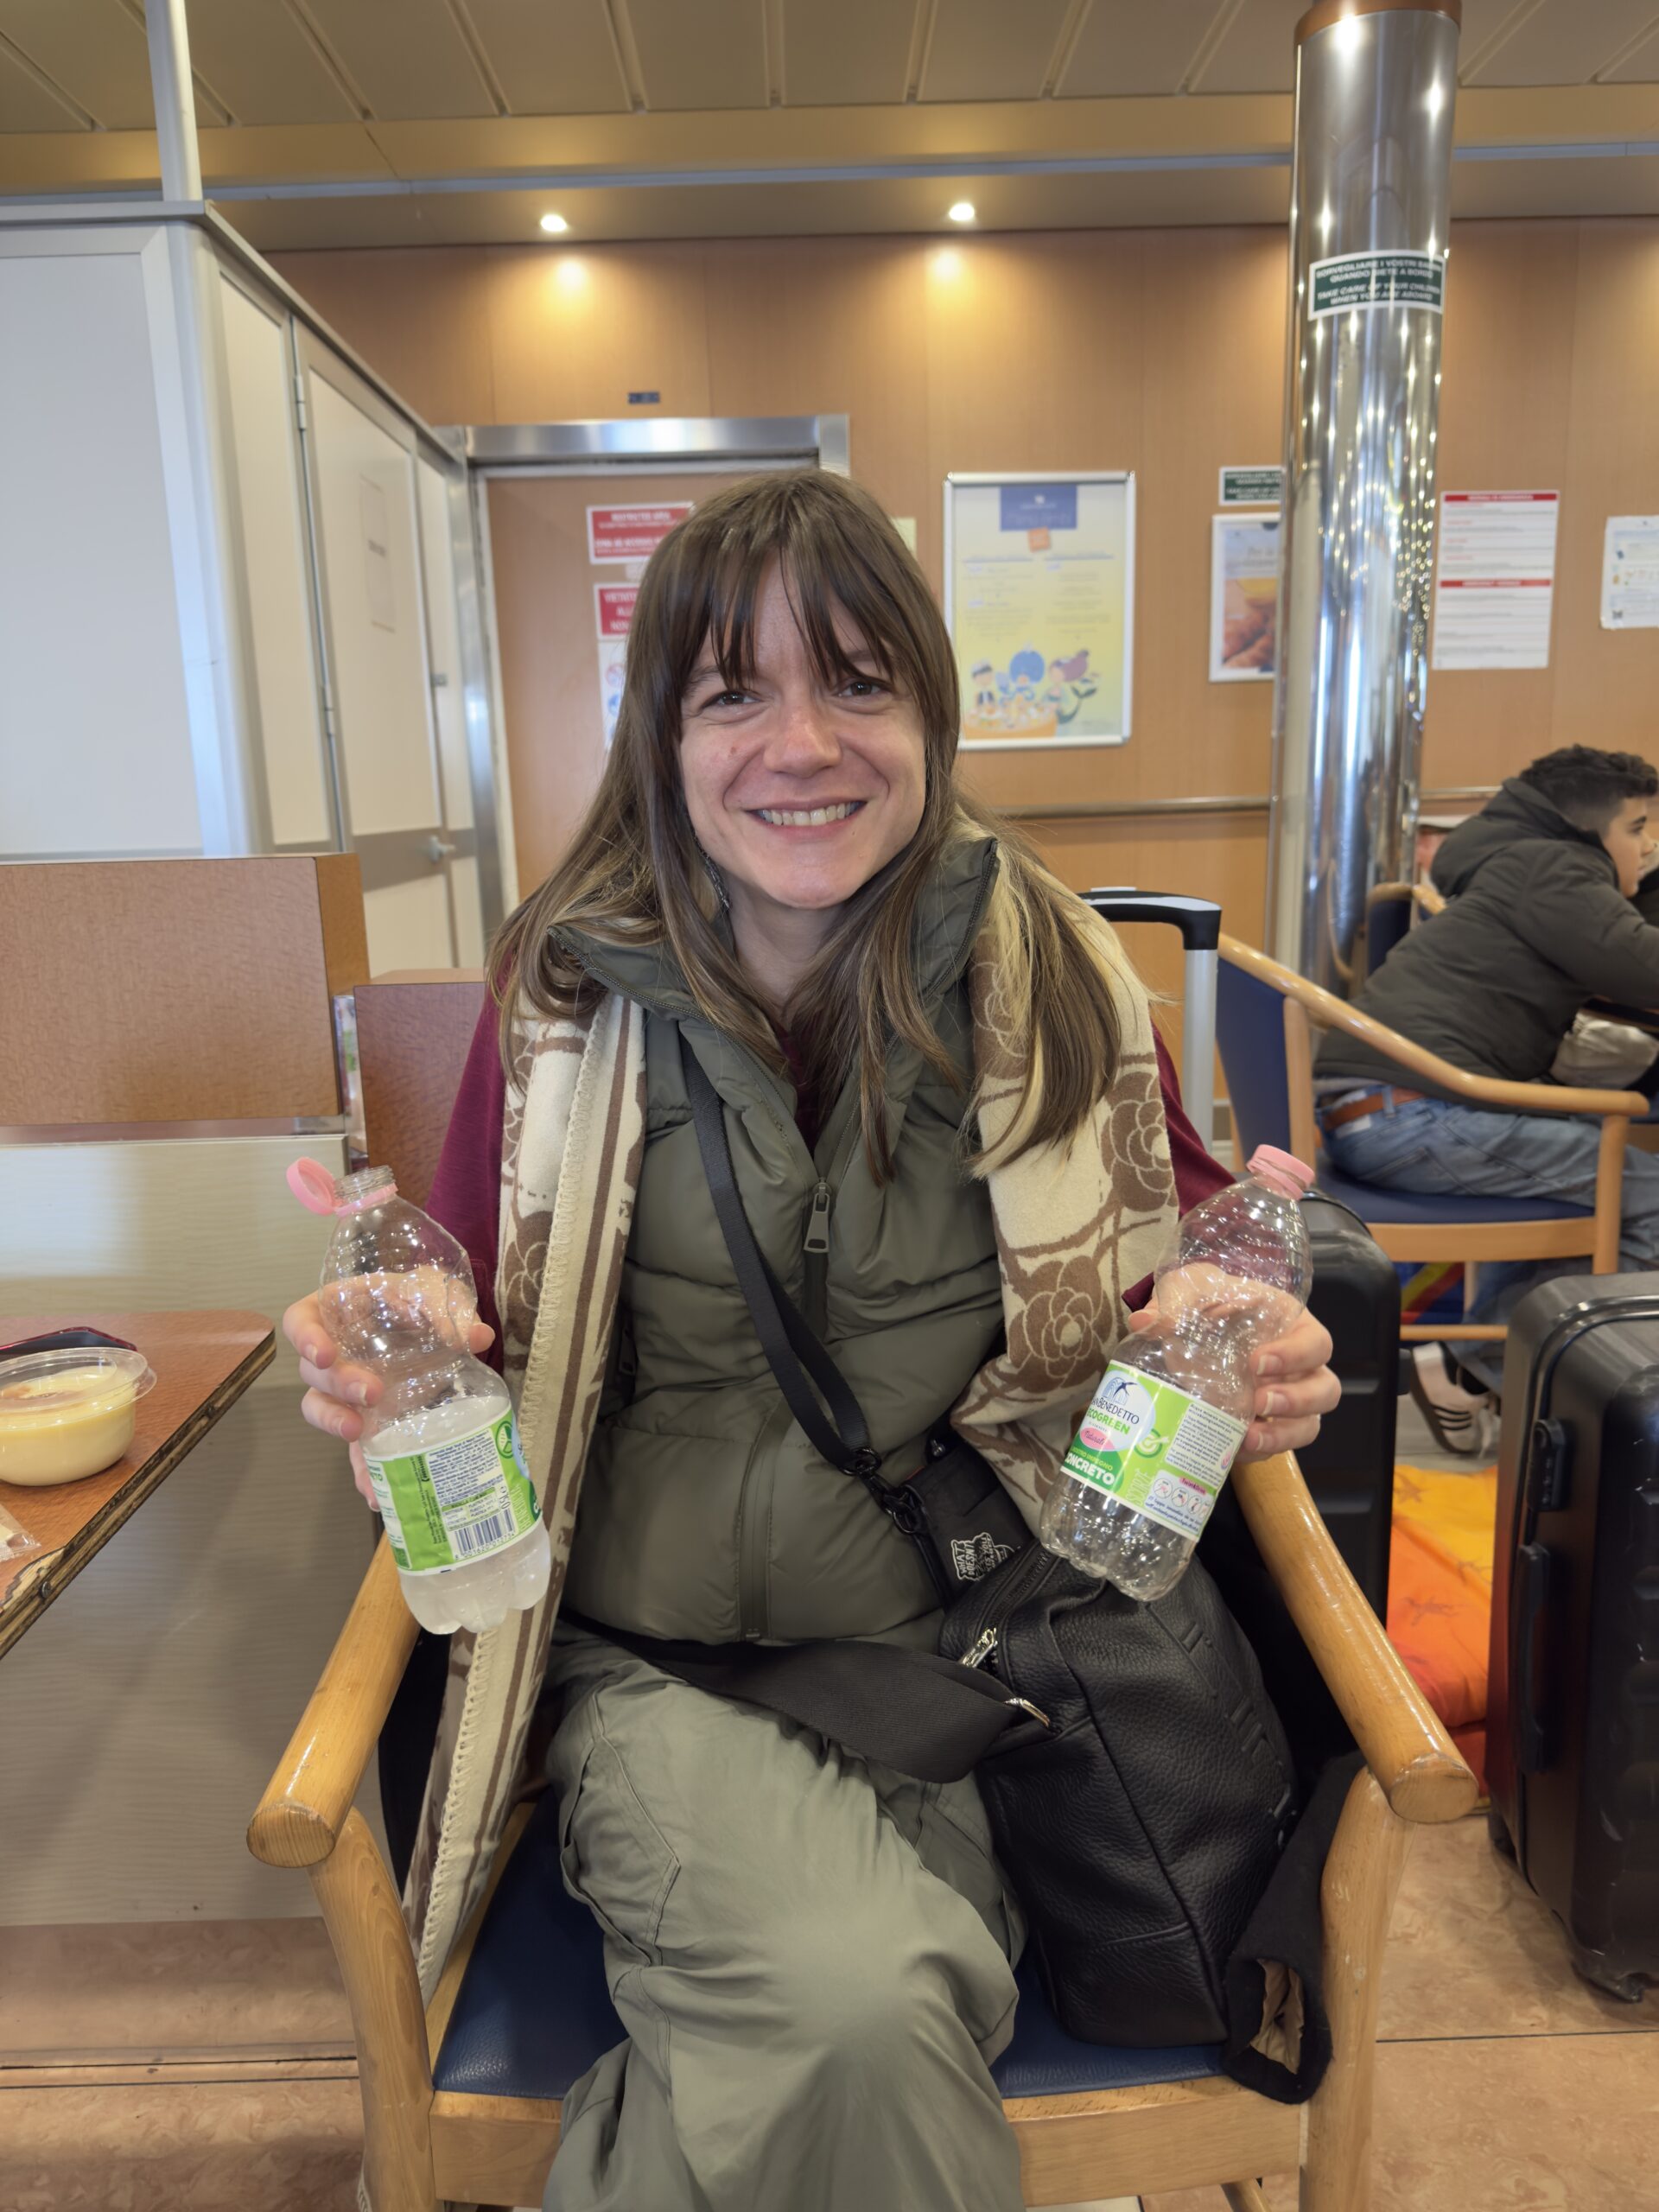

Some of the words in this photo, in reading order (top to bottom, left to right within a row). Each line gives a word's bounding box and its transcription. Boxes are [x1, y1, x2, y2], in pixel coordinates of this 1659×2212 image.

[1330, 270, 1370, 283] QUANDO
[1408, 269, 1433, 279] BORDO
[1318, 289, 1337, 300] TAKE
[1341, 284, 1364, 295] CARE
[1331, 294, 1357, 305] WHEN
[954, 1543, 967, 1574] WHAT
